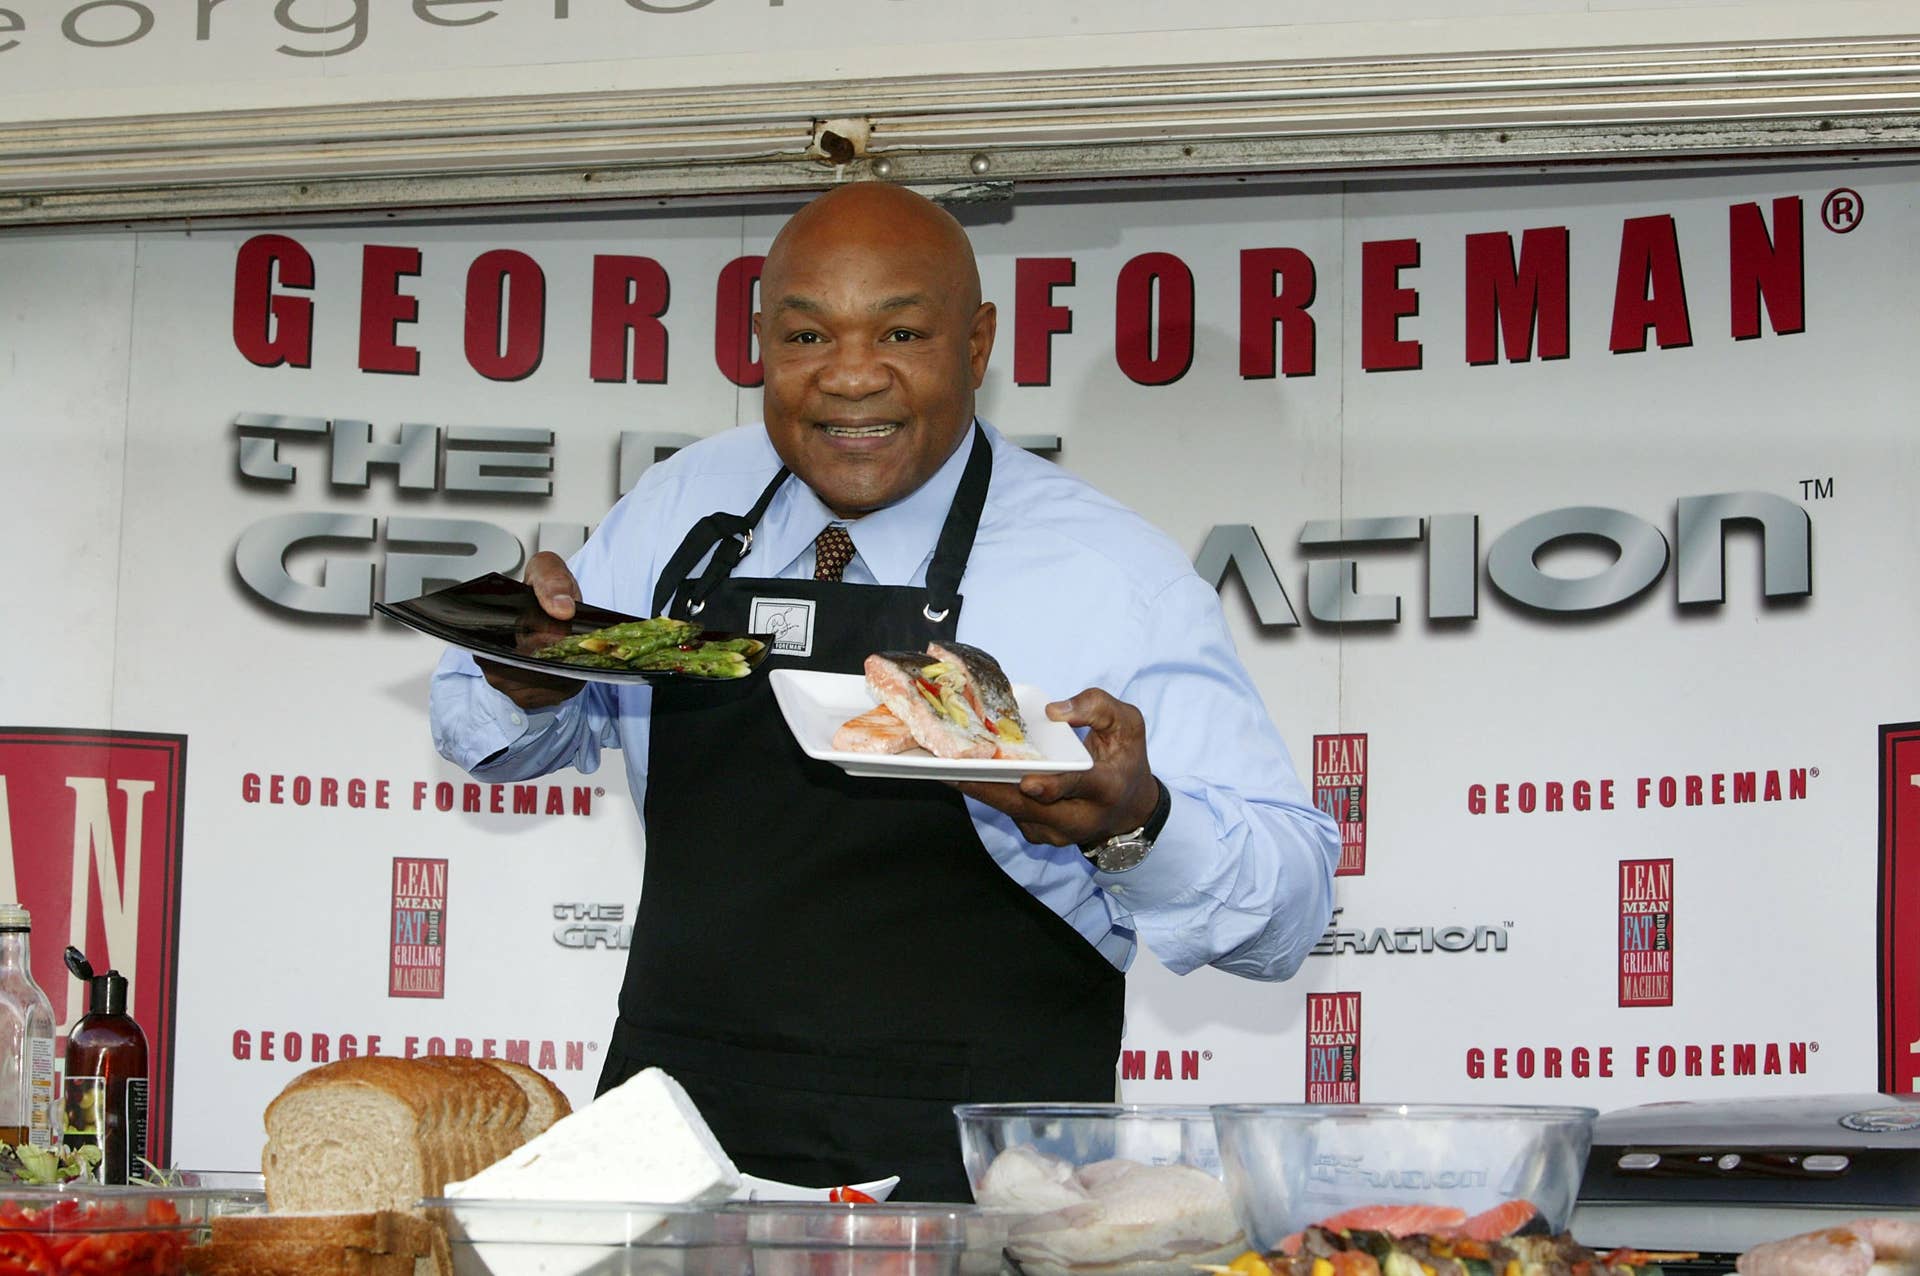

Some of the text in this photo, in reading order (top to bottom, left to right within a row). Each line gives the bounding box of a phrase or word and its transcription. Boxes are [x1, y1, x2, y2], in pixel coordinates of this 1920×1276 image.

[232, 233, 767, 389] GEORG
[235, 412, 555, 496] THE
[1317, 739, 1364, 774] LEAN
[242, 773, 390, 809] GEORGE
[1317, 774, 1363, 787] MEAN
[1467, 779, 1615, 814] GEORGE
[396, 862, 445, 898] LEAN
[1622, 864, 1670, 901] LEAN
[395, 898, 443, 910] MEAN
[553, 903, 624, 921] THE
[1623, 901, 1669, 914] MEAN
[395, 911, 426, 945] FAT
[1623, 915, 1653, 951] FAT
[394, 945, 441, 967] GRILLING
[1623, 951, 1669, 974] GRILLING
[394, 967, 441, 992] MACHINE
[1623, 975, 1669, 1001] MACHINE
[1310, 997, 1358, 1033] LEAN
[232, 1029, 382, 1063] GEORGE
[1310, 1033, 1357, 1046] MEAN
[1310, 1046, 1340, 1083] FAT
[1466, 1046, 1614, 1079] GEORGE
[1310, 1082, 1356, 1104] GRILLING
